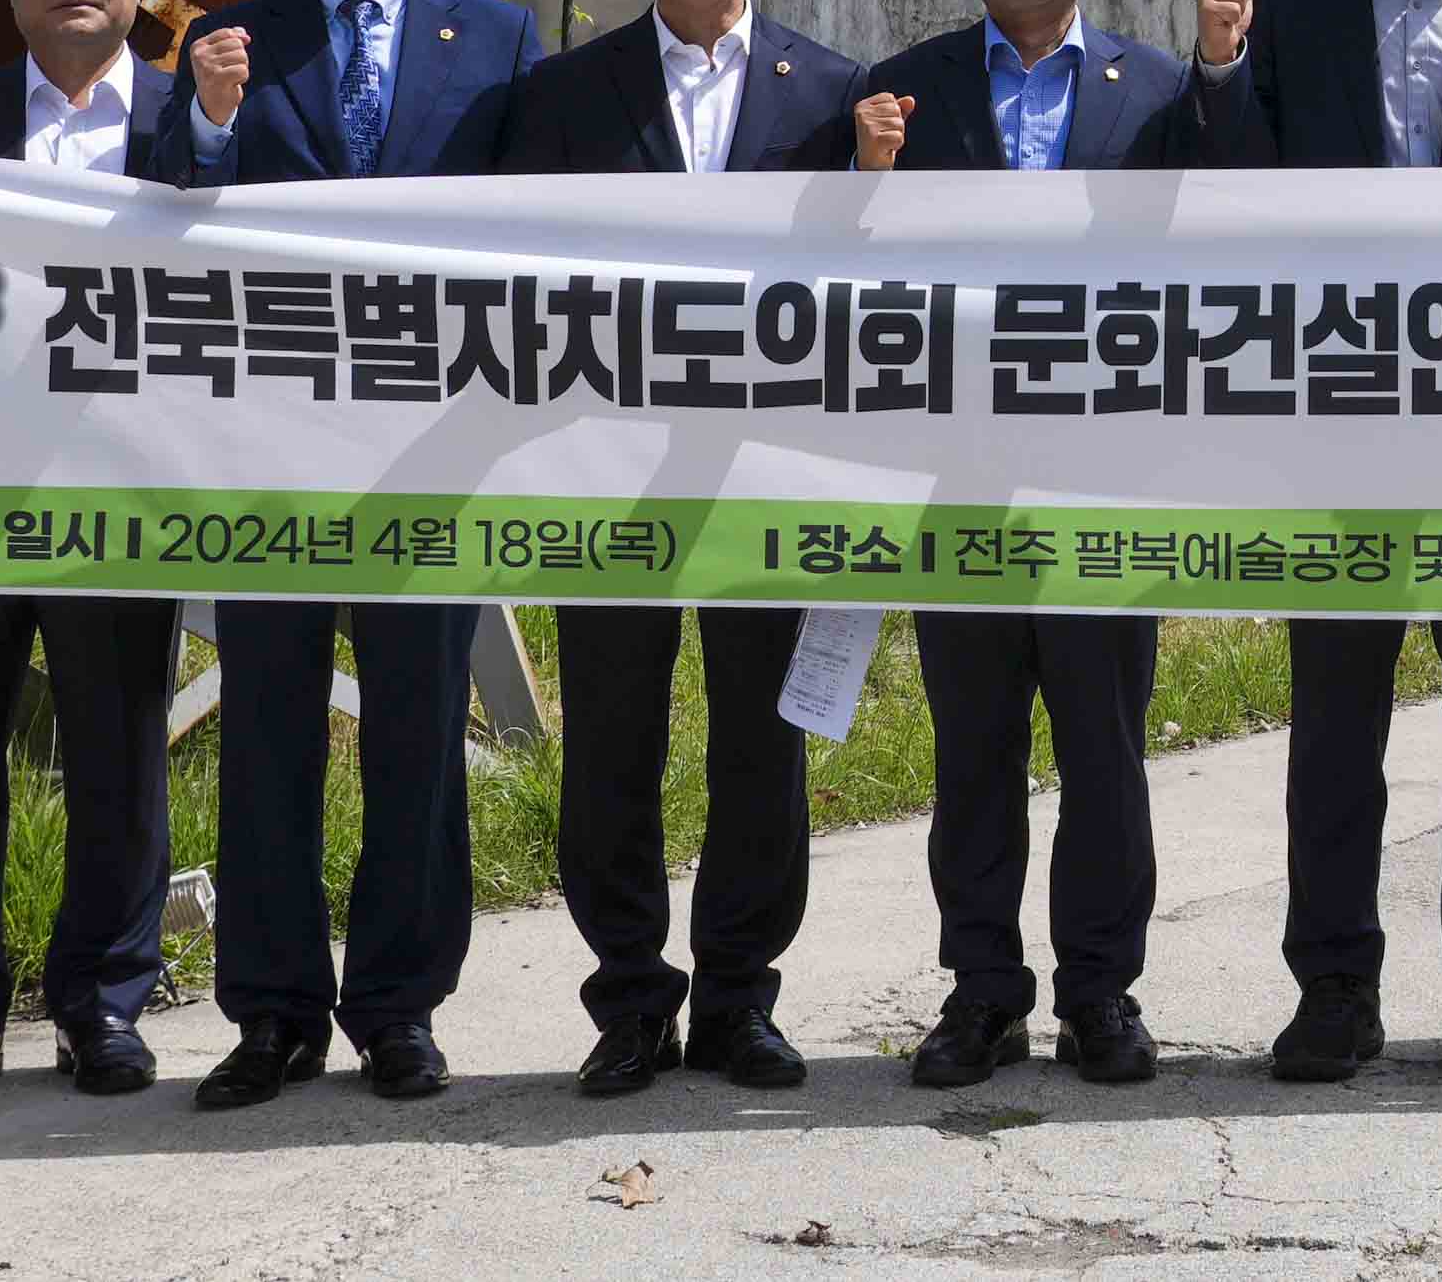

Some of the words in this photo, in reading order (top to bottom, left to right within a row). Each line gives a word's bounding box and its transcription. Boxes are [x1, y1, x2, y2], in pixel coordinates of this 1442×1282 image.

[44, 264, 956, 415] 전북특별자치도의회
[4, 509, 107, 562] 일시
[158, 513, 355, 567] 2024년
[370, 517, 458, 569] 4월
[475, 518, 677, 575] 18일(목)
[797, 524, 902, 575] 장소
[954, 527, 1059, 580] 전주
[1075, 529, 1397, 585] 팔복예술공장
